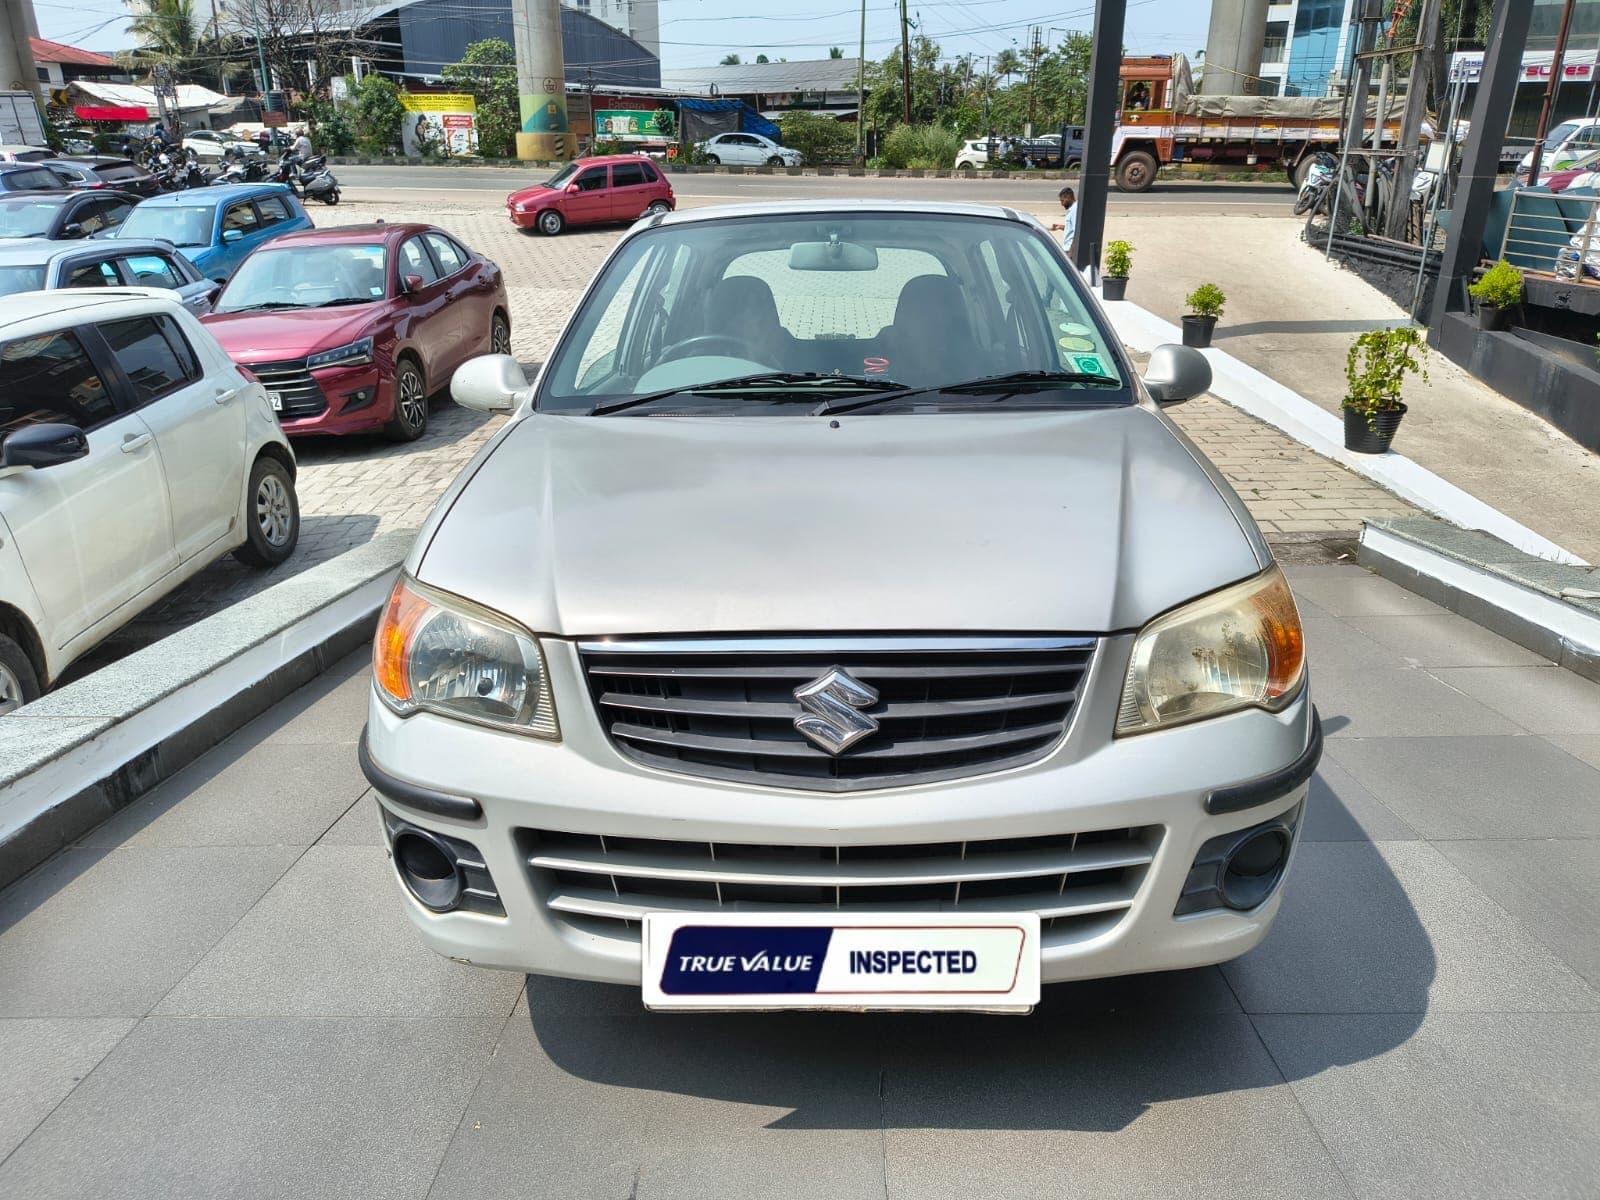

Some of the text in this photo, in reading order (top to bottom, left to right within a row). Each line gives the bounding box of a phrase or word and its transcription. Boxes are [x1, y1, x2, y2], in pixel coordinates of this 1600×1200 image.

[680, 950, 978, 975] TRUE VALUE INSPECTED
